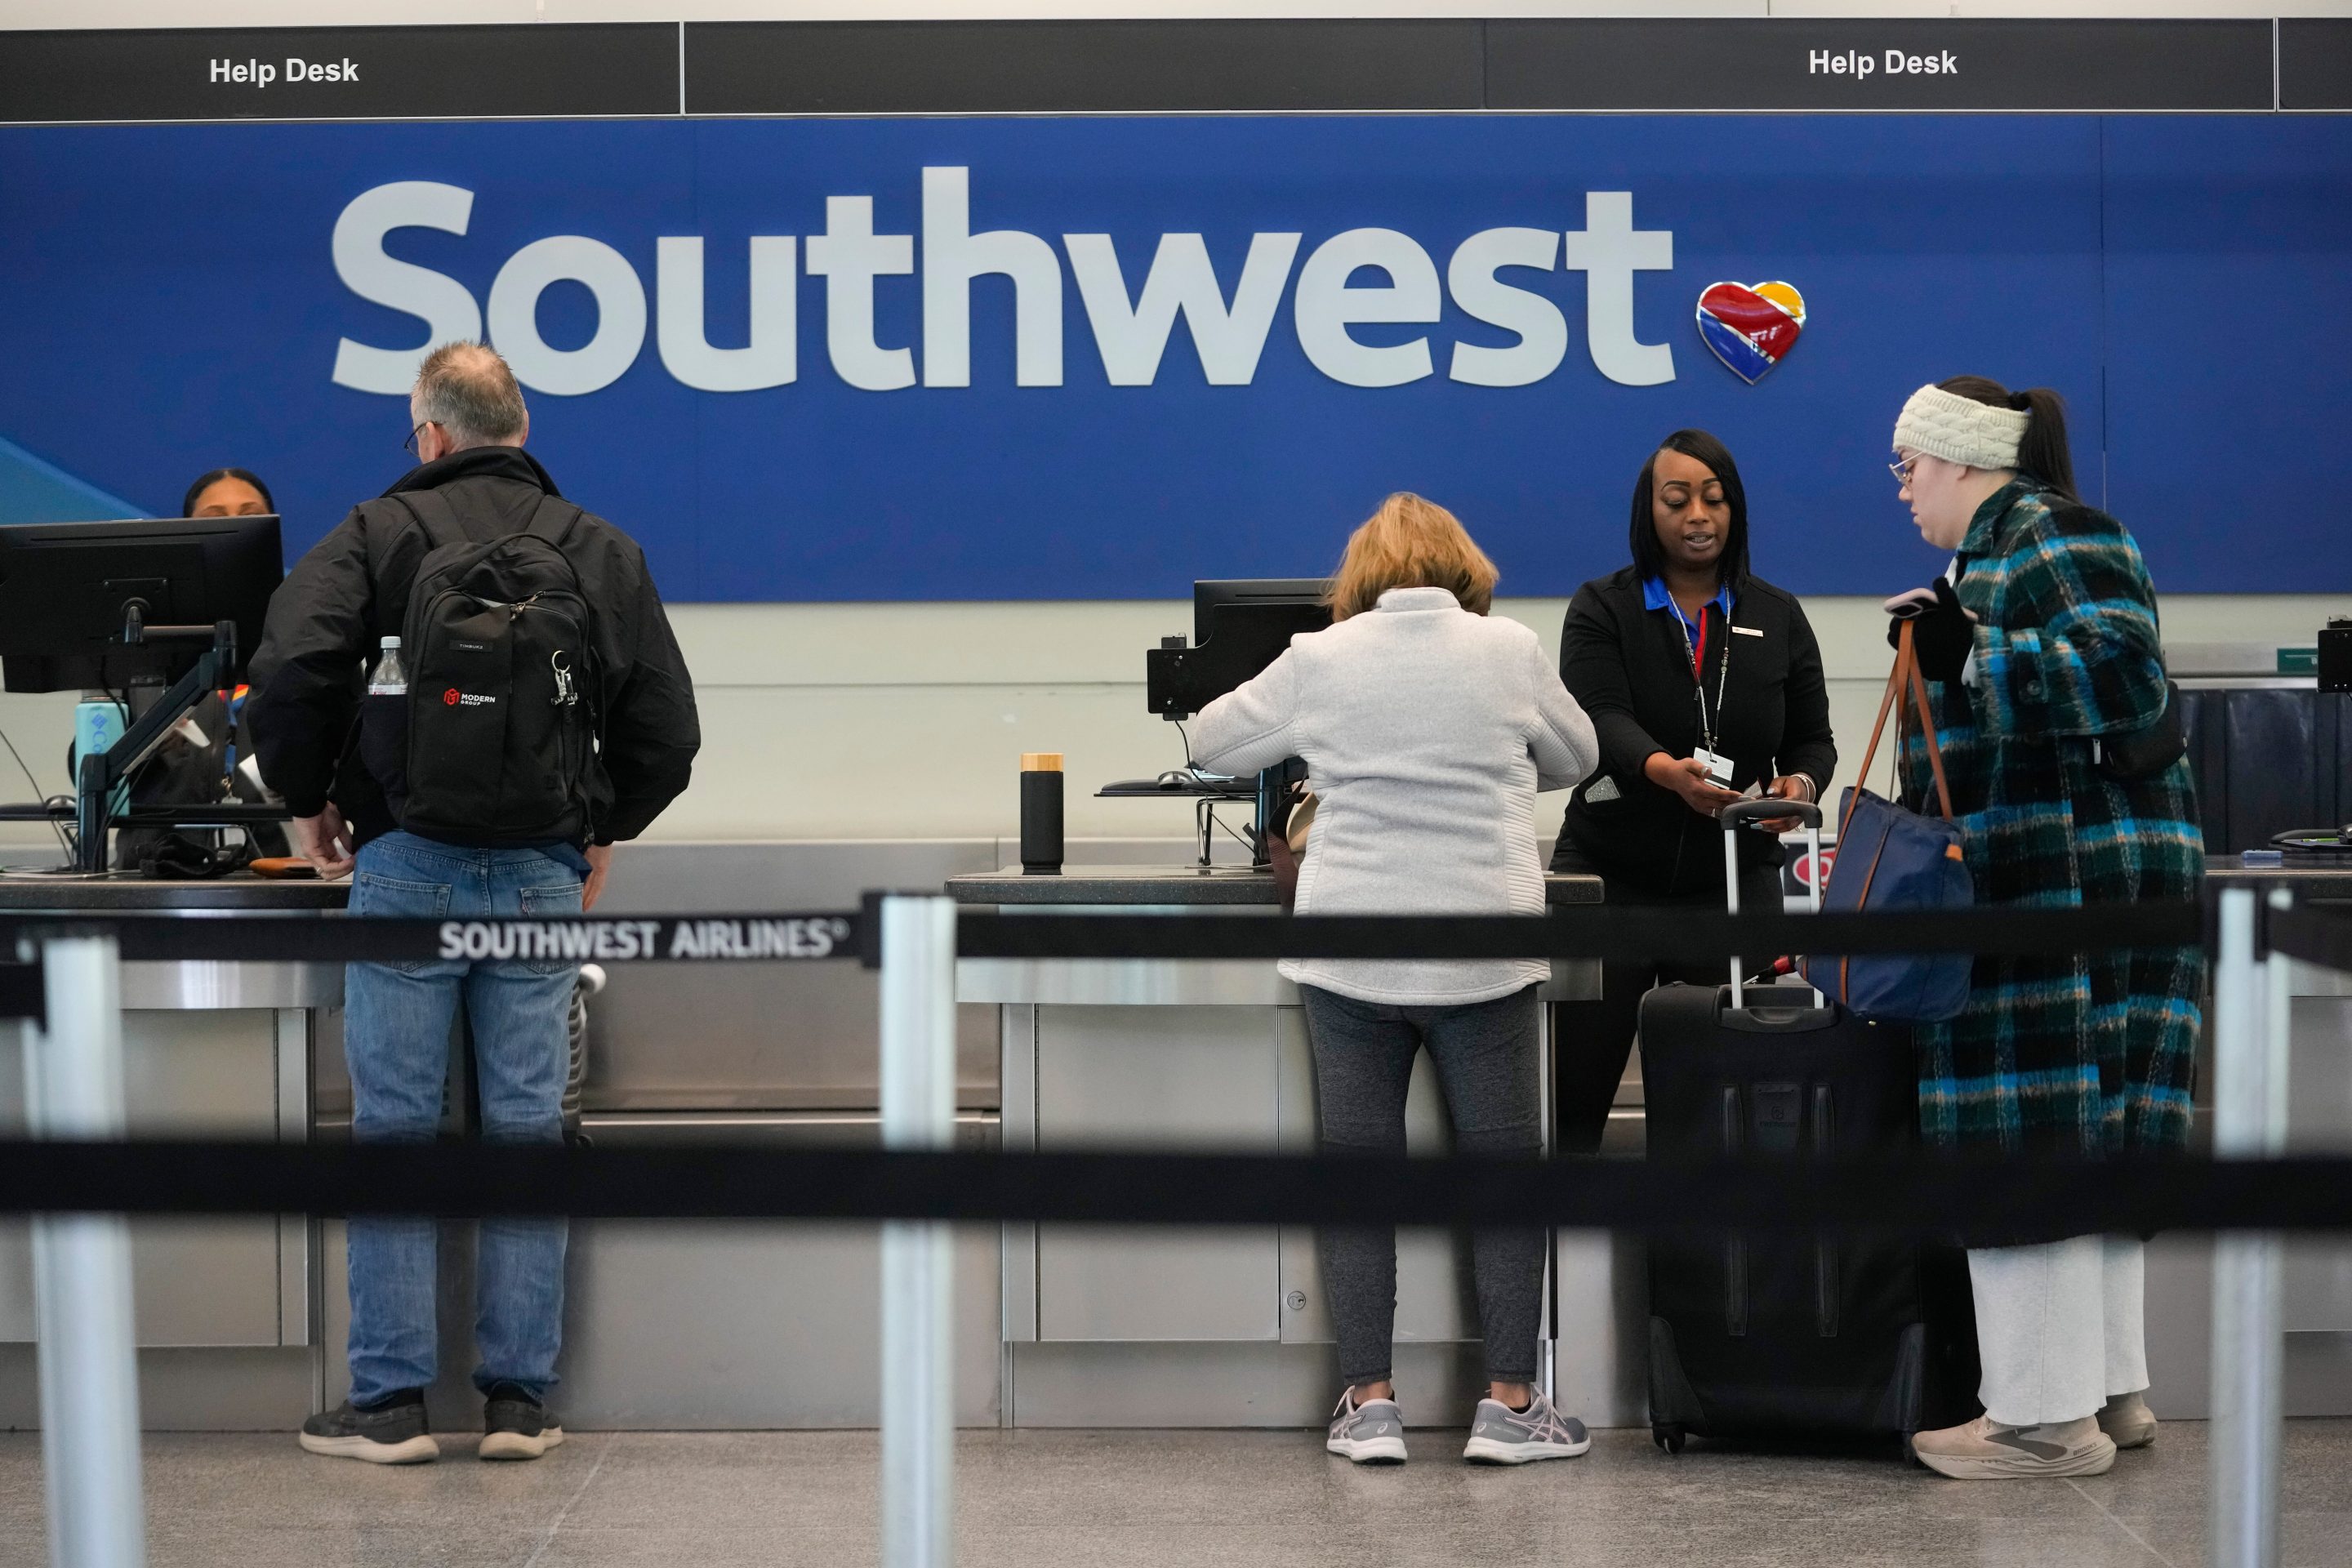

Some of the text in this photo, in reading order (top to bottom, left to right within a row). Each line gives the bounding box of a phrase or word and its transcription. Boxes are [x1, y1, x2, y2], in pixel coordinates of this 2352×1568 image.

[210, 57, 359, 88] Help Desk
[1810, 49, 1959, 80] Help Desk
[332, 166, 1675, 395] Southwest
[461, 693, 496, 702] MODERN
[439, 920, 661, 960] SOUTHWEST
[2073, 1442, 2097, 1455] BROOKS
